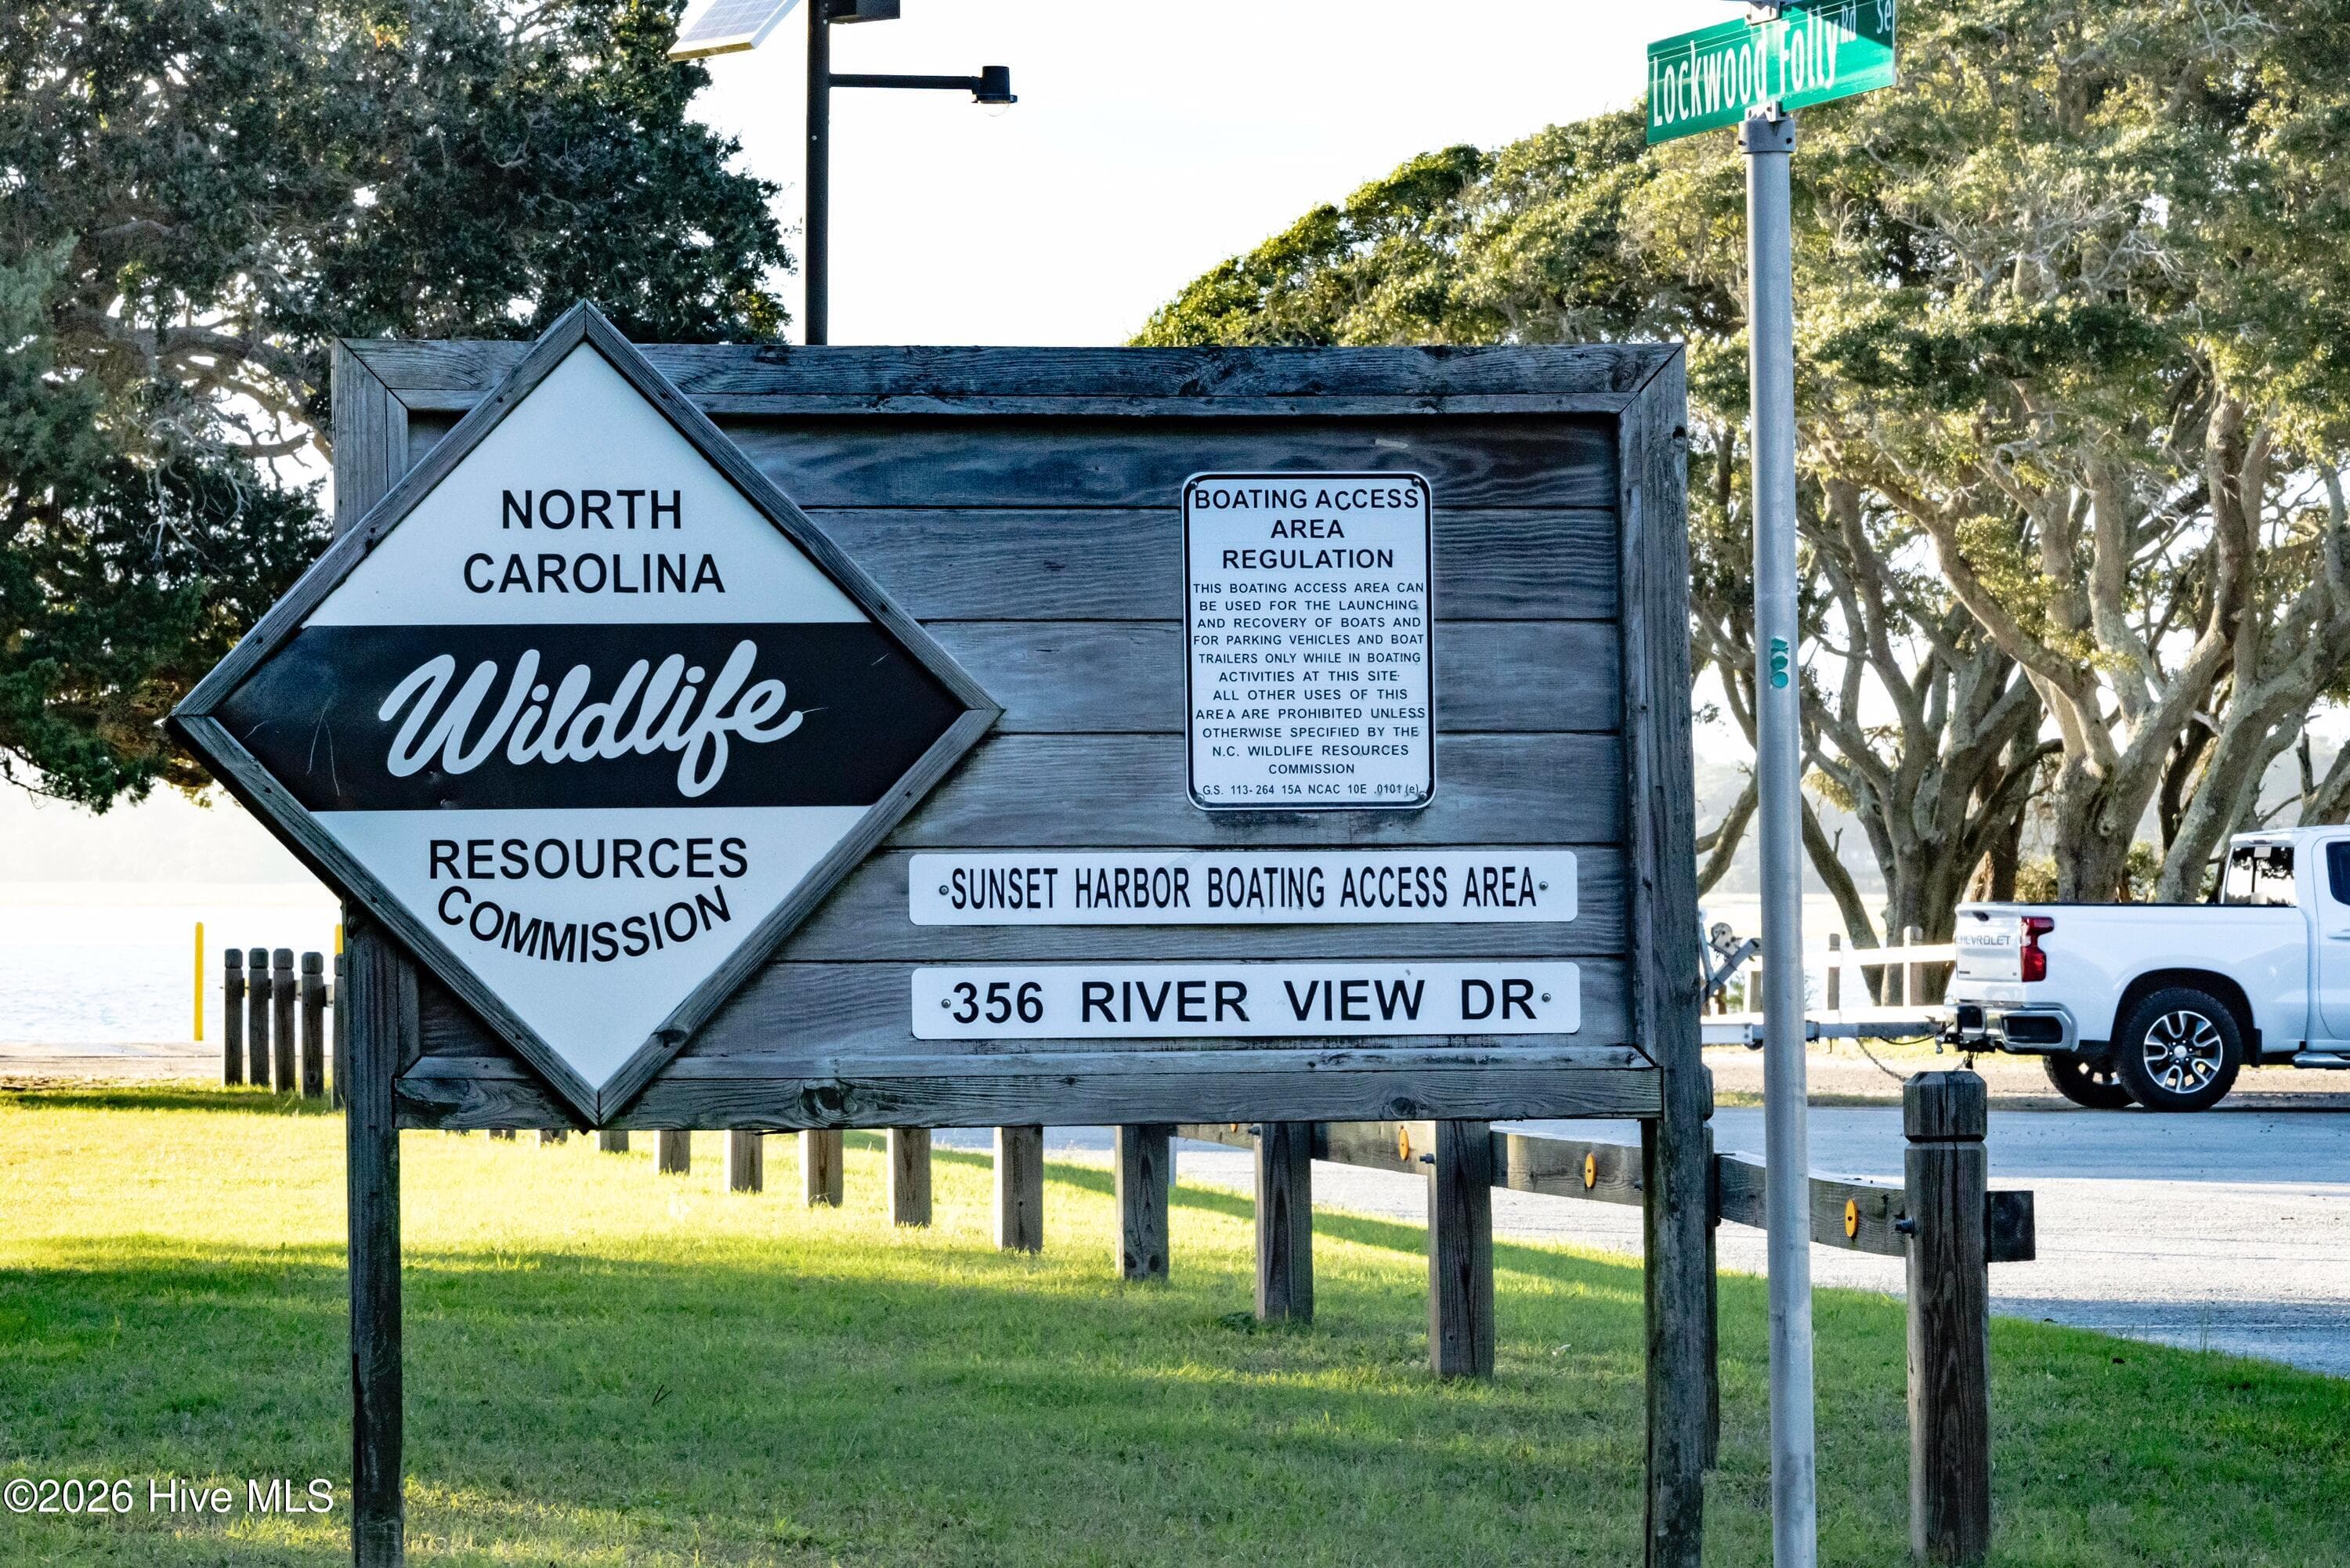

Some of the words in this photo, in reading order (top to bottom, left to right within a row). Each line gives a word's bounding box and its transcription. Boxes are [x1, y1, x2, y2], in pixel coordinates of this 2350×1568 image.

[1654, 23, 1767, 126] Lockwood
[1780, 6, 1838, 95] Folly
[1841, 0, 1856, 44] Rd
[1195, 490, 1307, 508] BOATING
[1315, 489, 1418, 511] ACCESS
[503, 490, 681, 529] NORTH
[1271, 519, 1344, 538] AREA
[1224, 549, 1393, 569] REGULATION
[464, 553, 725, 593] CAROLINA
[1193, 583, 1221, 593] THIS
[1230, 583, 1286, 593] BOATING
[1294, 583, 1347, 593] ACCESS
[1354, 583, 1390, 592] AREA
[1397, 583, 1423, 592] CAN
[1200, 602, 1216, 611] BE
[1226, 601, 1260, 611] USED
[1270, 601, 1296, 610] FOR
[1305, 601, 1330, 610] THE
[1340, 600, 1418, 610] LAUNCHING
[1198, 619, 1225, 627] AND
[1235, 618, 1307, 627] RECOVERY
[1315, 618, 1332, 627] OF
[1341, 617, 1385, 627] BOATS
[1394, 617, 1420, 627] AND
[1194, 636, 1218, 645] FOR
[1227, 635, 1281, 645] PARKING
[1289, 634, 1350, 645] VEHICLES
[1358, 634, 1383, 644] AND
[1391, 634, 1423, 644] BOAT
[1199, 653, 1257, 663] TRAILERS
[1265, 653, 1296, 663] ONLY
[1303, 653, 1341, 663] WHILE
[1349, 653, 1359, 663] IN
[1368, 652, 1420, 663] BOATING
[1219, 671, 1294, 681] ACTIVITIES
[1303, 671, 1319, 681] AT
[1329, 671, 1358, 681] THIS
[1213, 691, 1238, 700] ALL
[1248, 690, 1295, 700] OTHER
[1304, 689, 1340, 699] USES
[1350, 689, 1368, 699] OF
[1377, 689, 1407, 699] THIS
[378, 639, 803, 797] Wildlife
[1196, 710, 1235, 719] AREA
[1242, 709, 1269, 719] ARE
[1278, 708, 1361, 718] PROHIBITED
[1371, 708, 1425, 718] UNLESS
[1203, 728, 1282, 738] OTHERWISE
[1291, 728, 1359, 737] SPECIFIED
[1368, 728, 1384, 736] BY
[1394, 727, 1419, 737] THE
[1213, 746, 1238, 757] N.C.
[1248, 746, 1313, 756] WILDLIFE
[1322, 745, 1408, 756] RESOURCES
[1269, 764, 1354, 774] COMMISSION
[1203, 786, 1224, 795] G.S.
[1282, 785, 1301, 794] 15A
[1309, 784, 1340, 794] NCAC
[1348, 784, 1366, 793] 10E
[429, 837, 748, 880] RESOURCES
[952, 868, 1058, 909] SUNSET
[1076, 867, 1191, 908] HARBOR
[1208, 867, 1324, 909] BOATING
[1340, 866, 1447, 908] ACCESS
[1463, 866, 1536, 907] AREA
[438, 884, 732, 963] COMMISSION
[953, 982, 1043, 1024] 356
[1083, 981, 1249, 1022] RIVER
[1284, 980, 1425, 1021] VIEW
[1462, 979, 1537, 1020] DR
